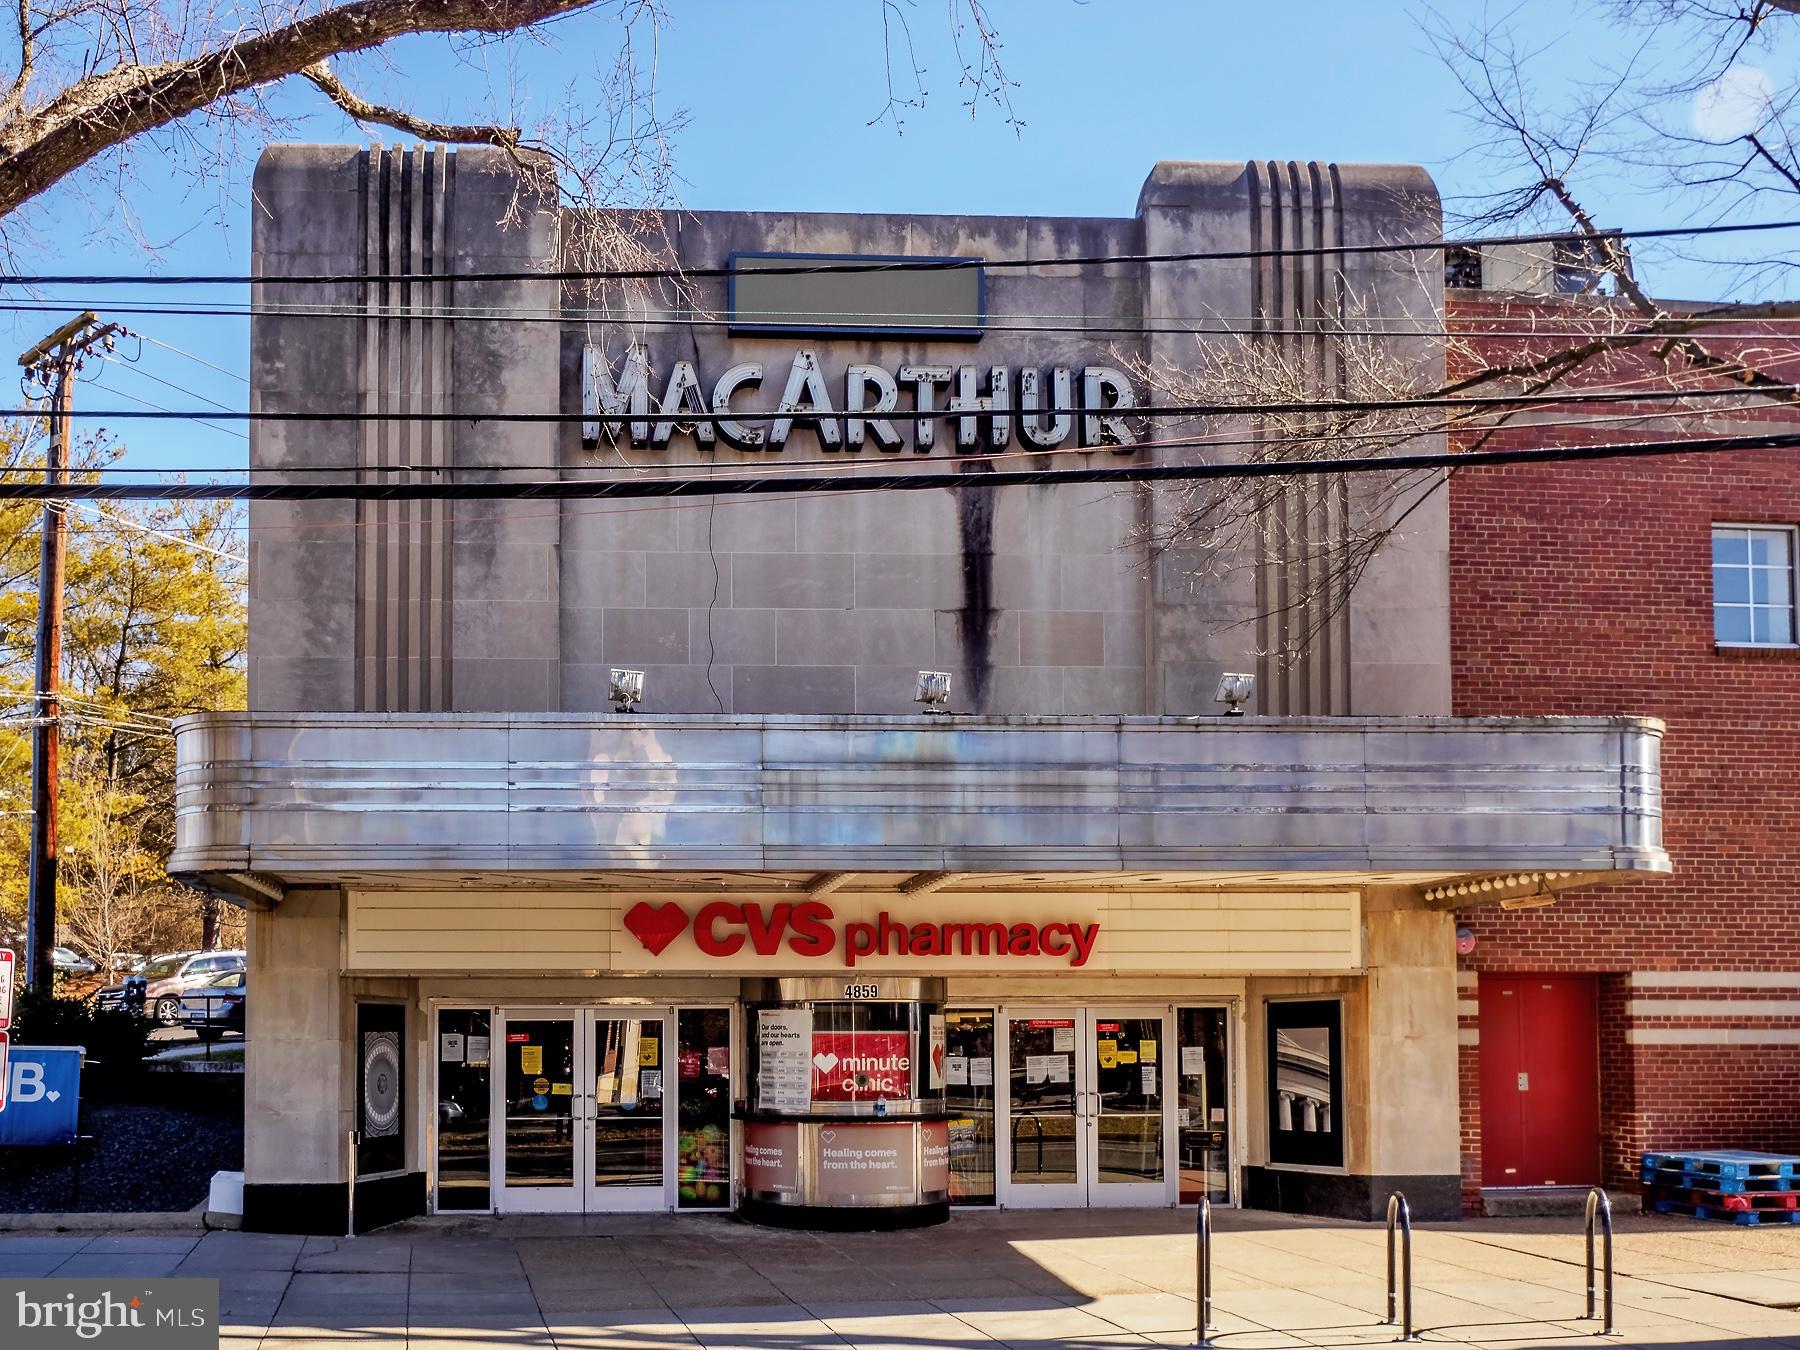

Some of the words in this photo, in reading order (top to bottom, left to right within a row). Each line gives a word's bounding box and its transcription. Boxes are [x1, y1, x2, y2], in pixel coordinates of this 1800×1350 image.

[582, 344, 1137, 453] MACARTHUR
[693, 902, 836, 957] CVS
[844, 911, 1100, 967] pharmacy
[844, 984, 879, 999] 4859
[780, 1031, 800, 1039] hearts
[842, 1053, 910, 1071] minute
[842, 1073, 893, 1092] cnic
[760, 1147, 783, 1156] comes
[823, 1147, 863, 1160] Healing
[864, 1149, 897, 1158] comes
[823, 1160, 848, 1169] from
[849, 1160, 868, 1169] the
[868, 1160, 898, 1169] heart.
